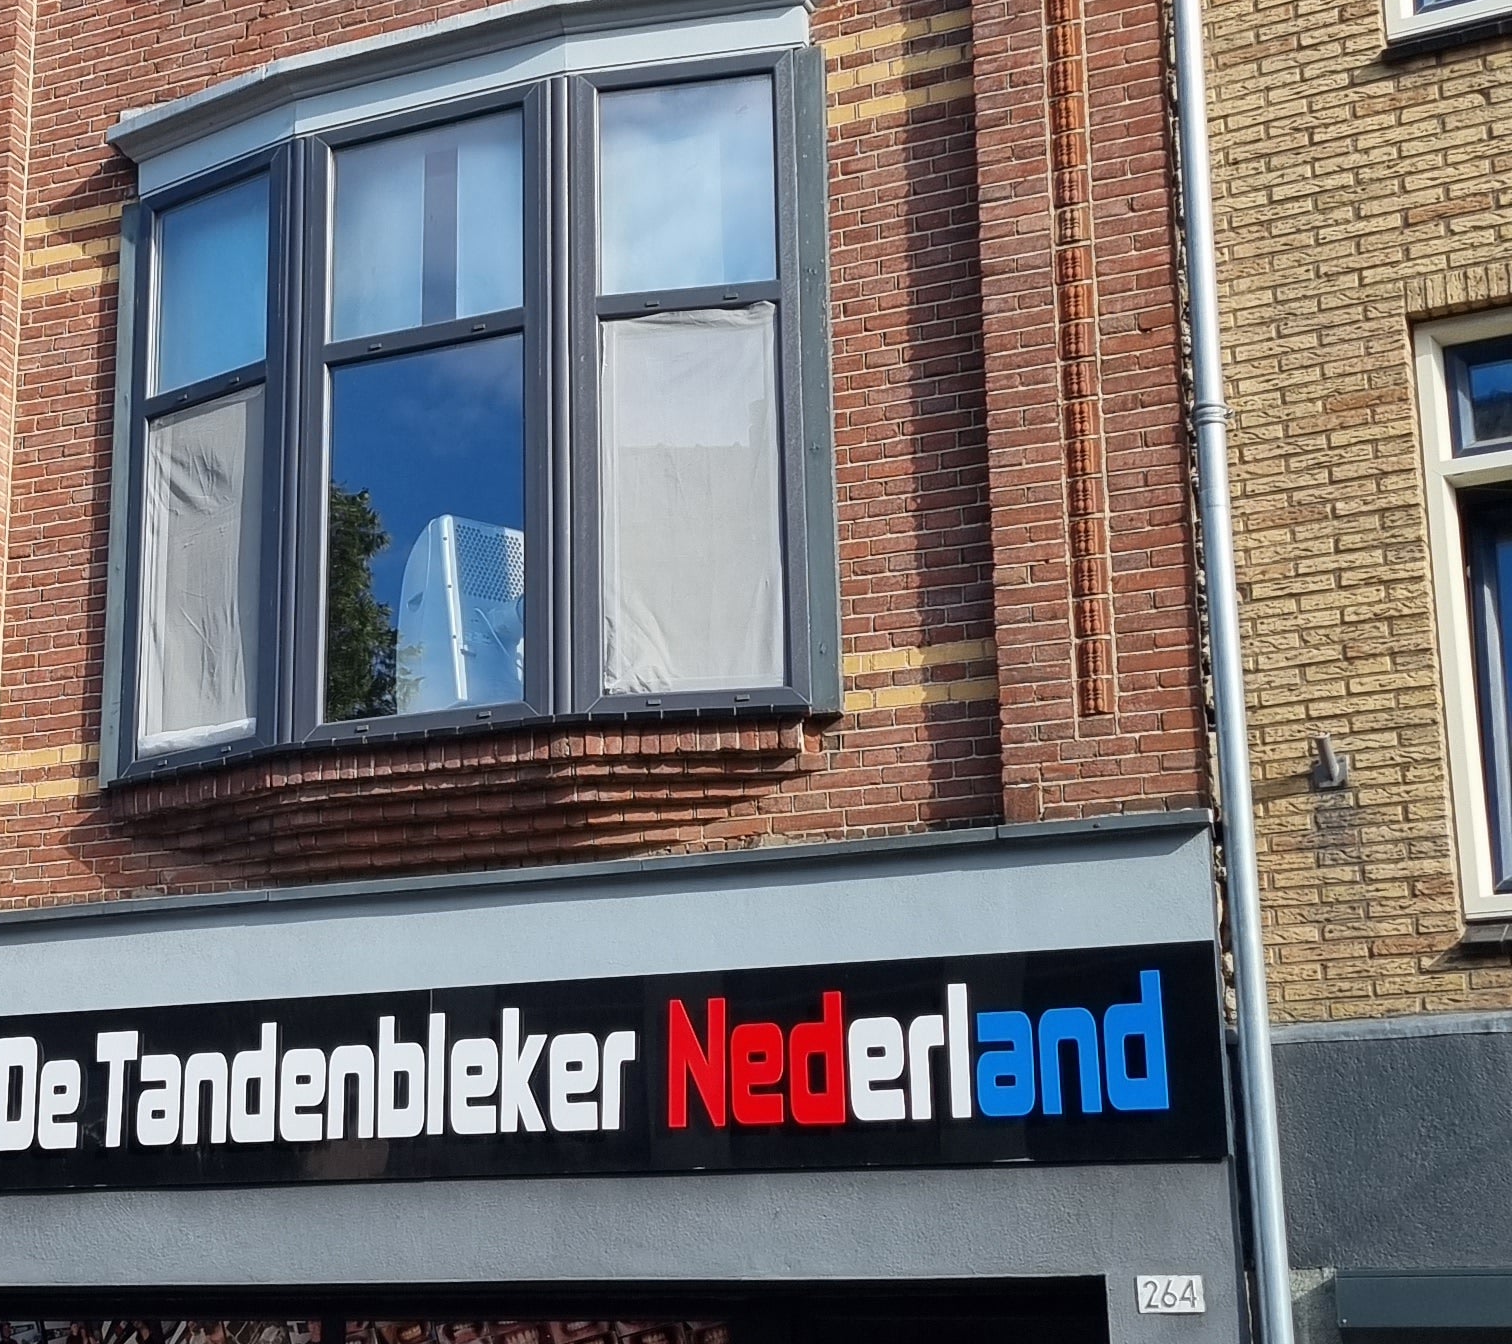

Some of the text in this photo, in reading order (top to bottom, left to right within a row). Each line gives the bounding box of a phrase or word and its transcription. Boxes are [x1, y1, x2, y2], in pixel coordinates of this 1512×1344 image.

[96, 1008, 636, 1147] Tandenbleker
[668, 970, 1169, 1128] Nederland
[1143, 1279, 1198, 1309] 264
